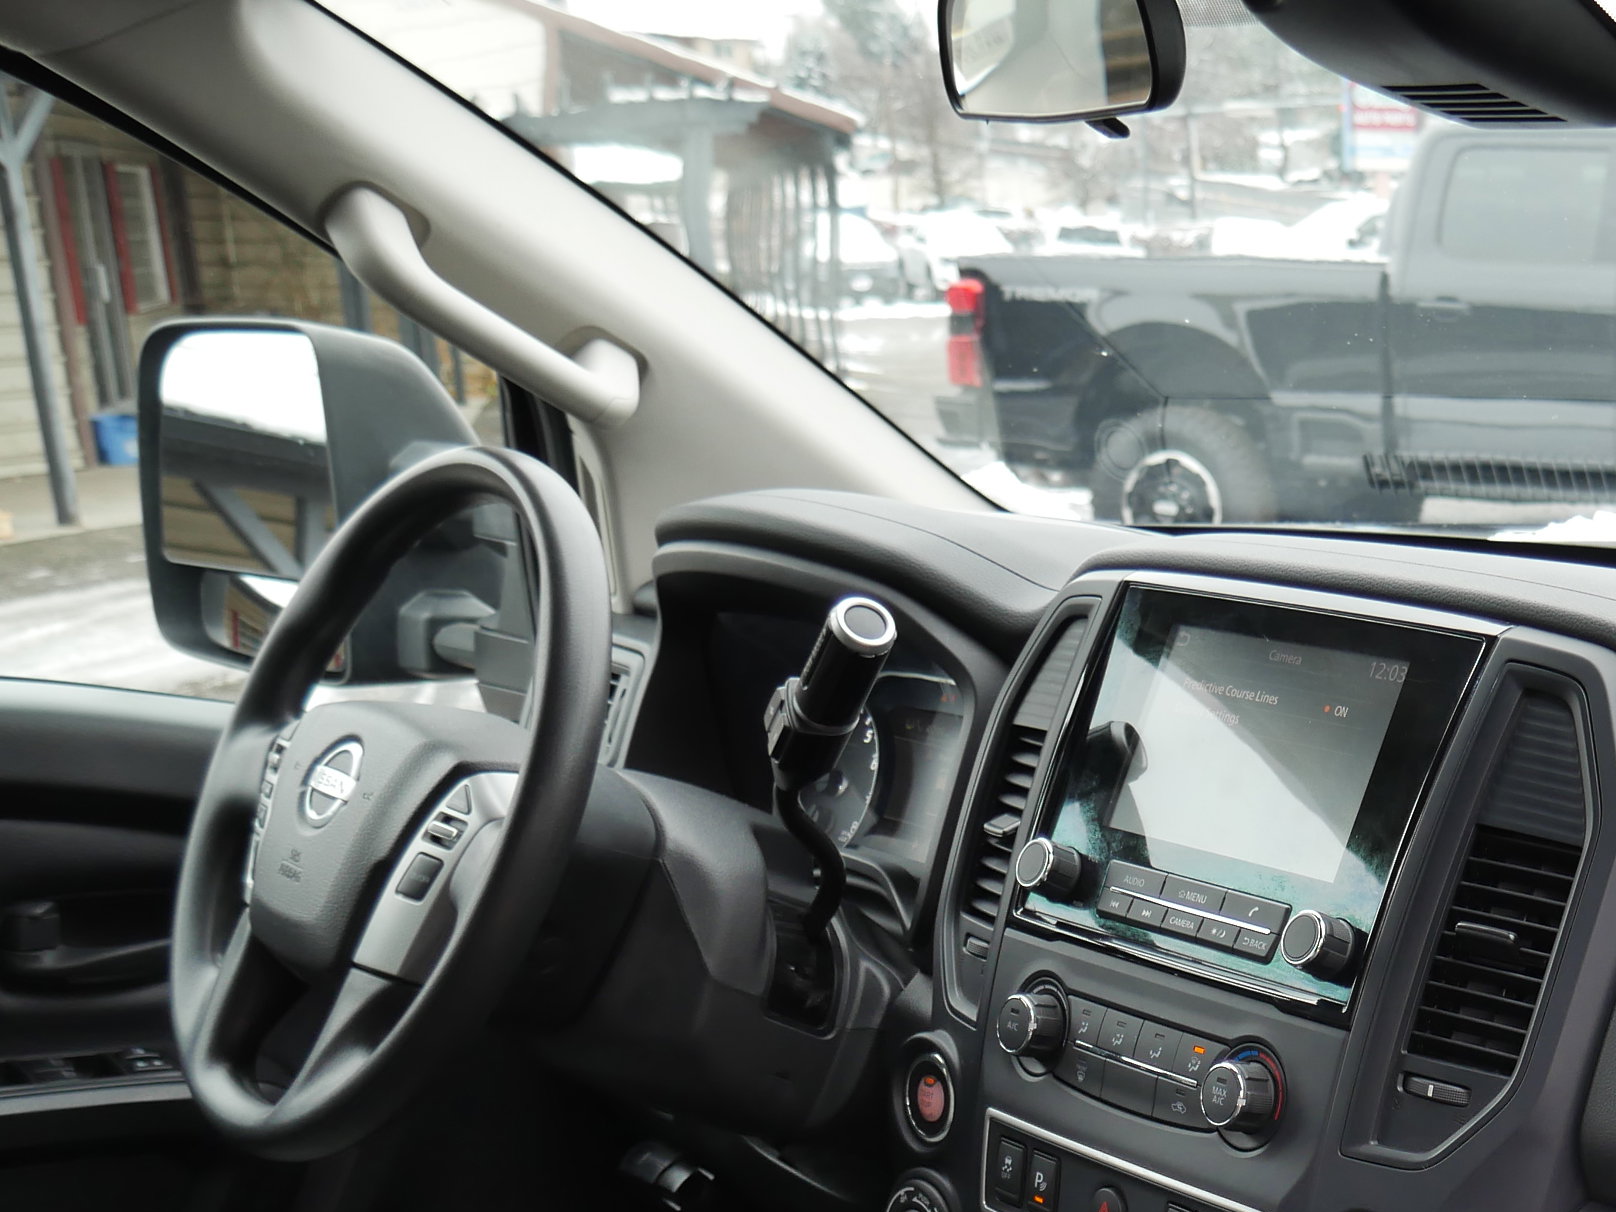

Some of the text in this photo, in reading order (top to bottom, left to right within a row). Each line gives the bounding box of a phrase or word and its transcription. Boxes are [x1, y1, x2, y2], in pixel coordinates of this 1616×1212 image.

[1269, 650, 1303, 665] Camera
[1369, 661, 1408, 683] 12:03
[1183, 678, 1279, 706] Predictive Course Lines
[1334, 705, 1349, 719] ON
[1123, 874, 1146, 888] AUDIO
[1184, 890, 1208, 905] MENU
[1169, 915, 1195, 930] CAMERA
[1250, 937, 1268, 951] BACK
[1006, 1019, 1019, 1032] A/C
[1211, 1085, 1228, 1097] MAX
[1211, 1094, 1225, 1107] A/C
